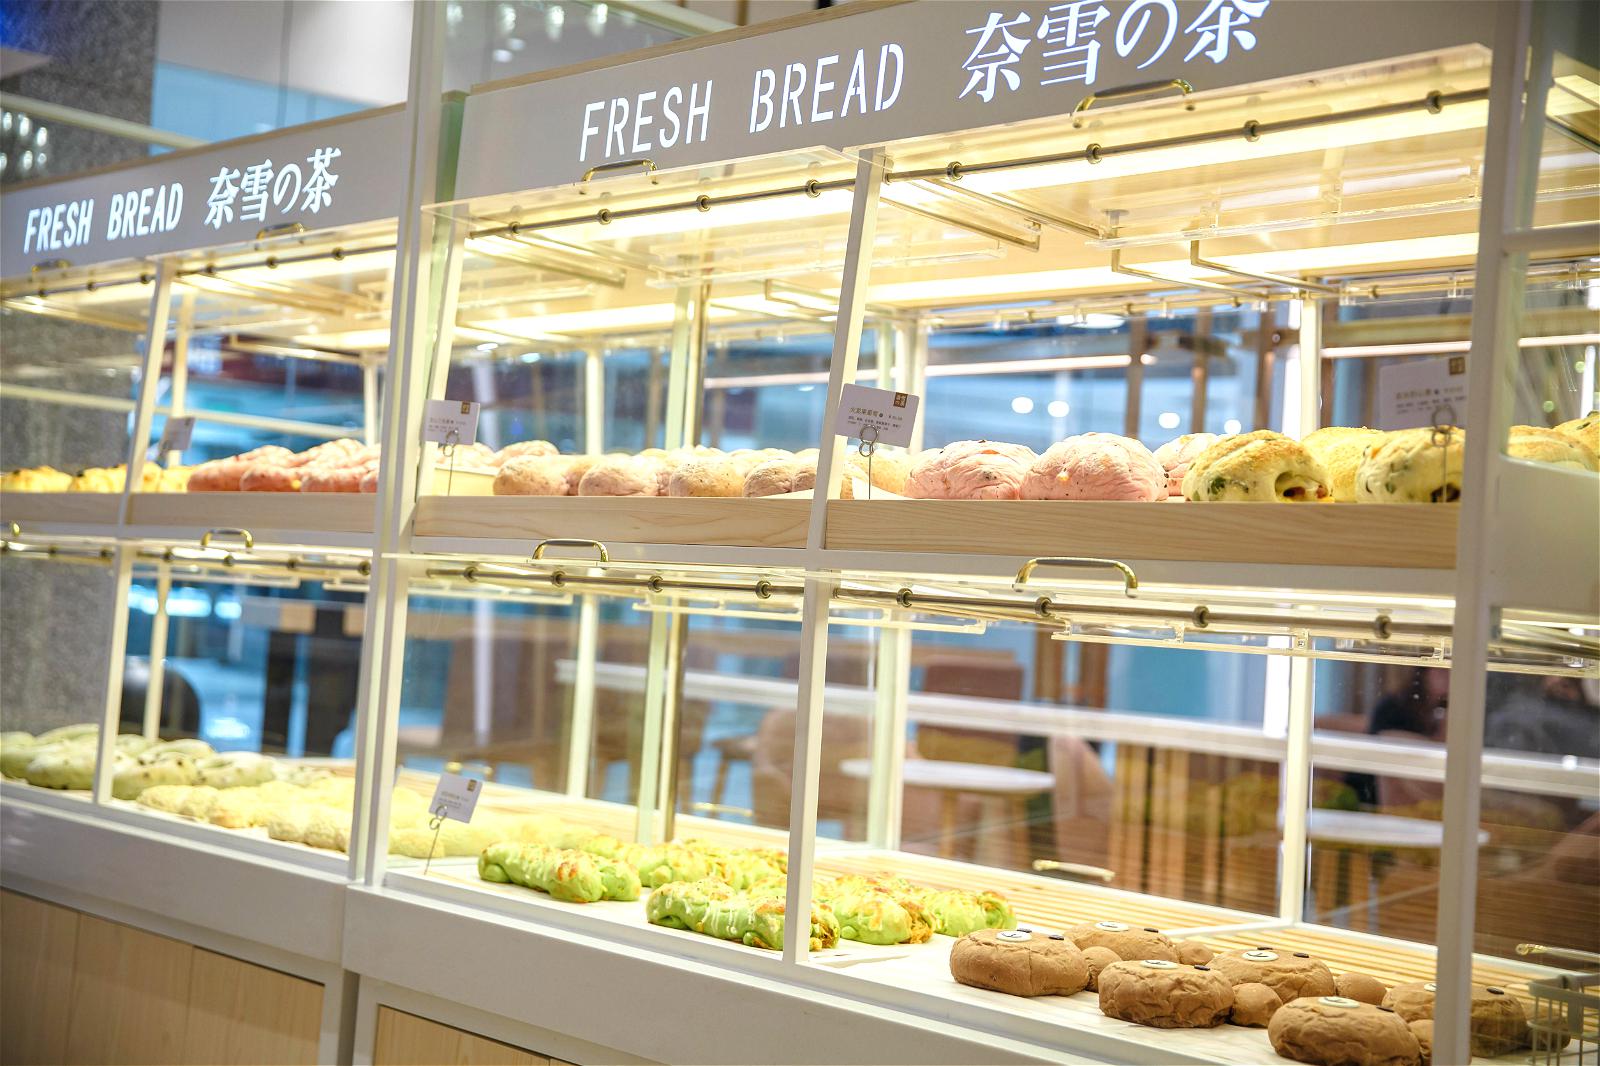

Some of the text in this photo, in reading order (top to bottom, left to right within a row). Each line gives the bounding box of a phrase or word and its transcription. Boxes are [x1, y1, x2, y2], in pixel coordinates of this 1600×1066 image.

[579, 43, 905, 162] FRESH BREAD
[23, 182, 184, 253] FRESH BREAD
[203, 147, 342, 231] 奈雪の茶
